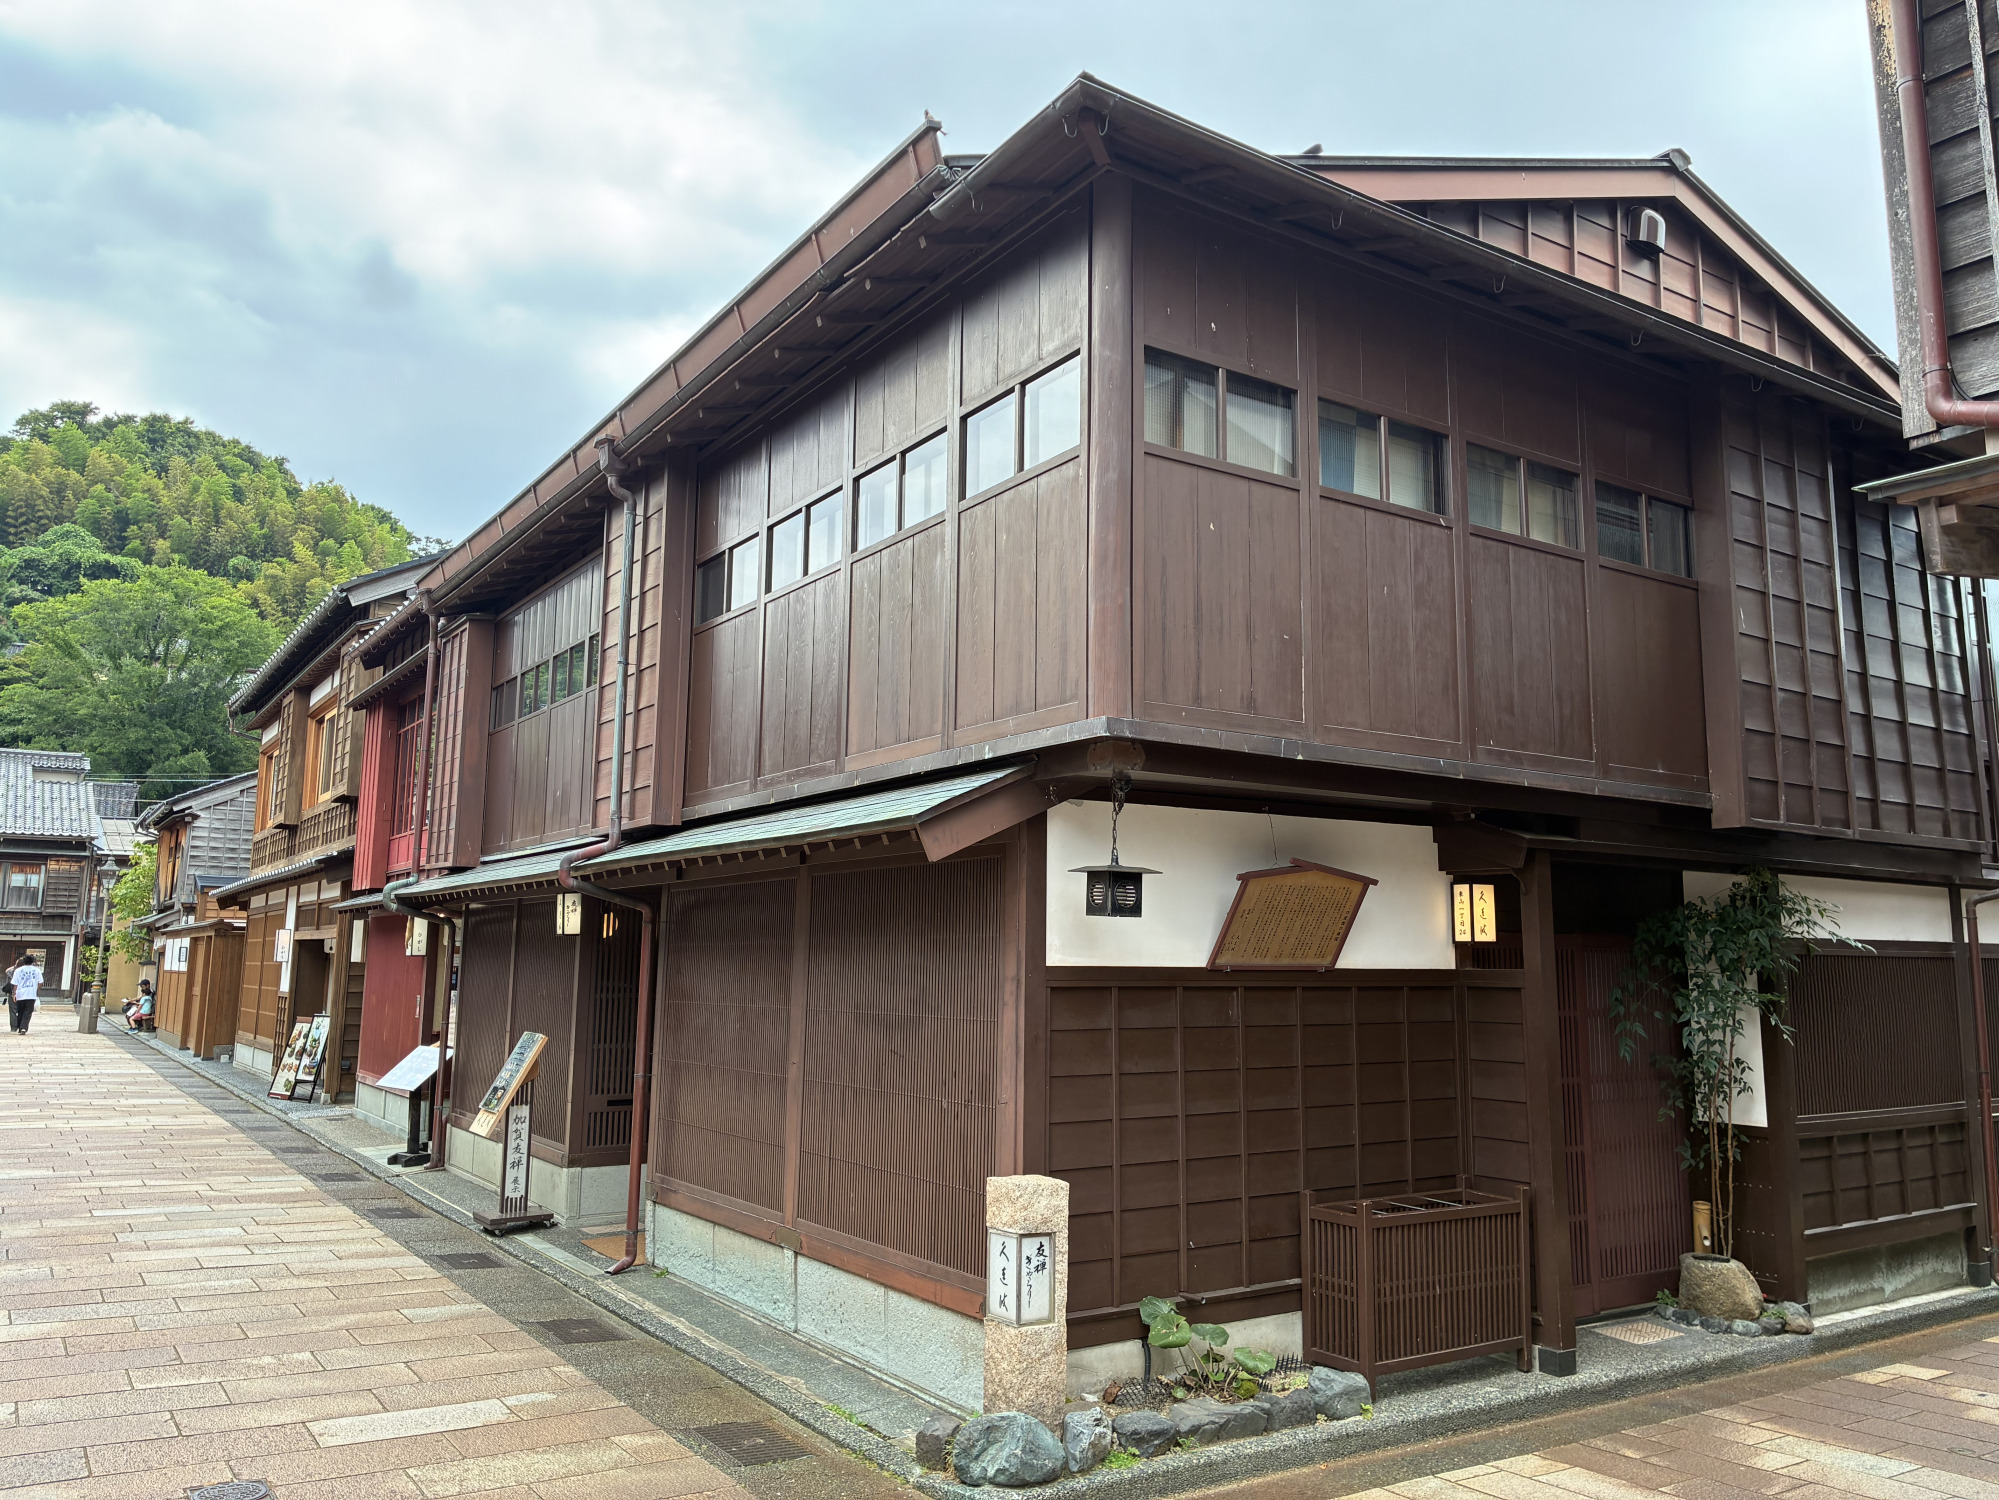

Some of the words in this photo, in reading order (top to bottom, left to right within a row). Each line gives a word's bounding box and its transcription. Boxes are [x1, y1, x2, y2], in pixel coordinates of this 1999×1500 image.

[509, 1113, 527, 1174] 加賀友禅
[510, 1175, 521, 1194] 展示
[1033, 1240, 1049, 1276] 友禅
